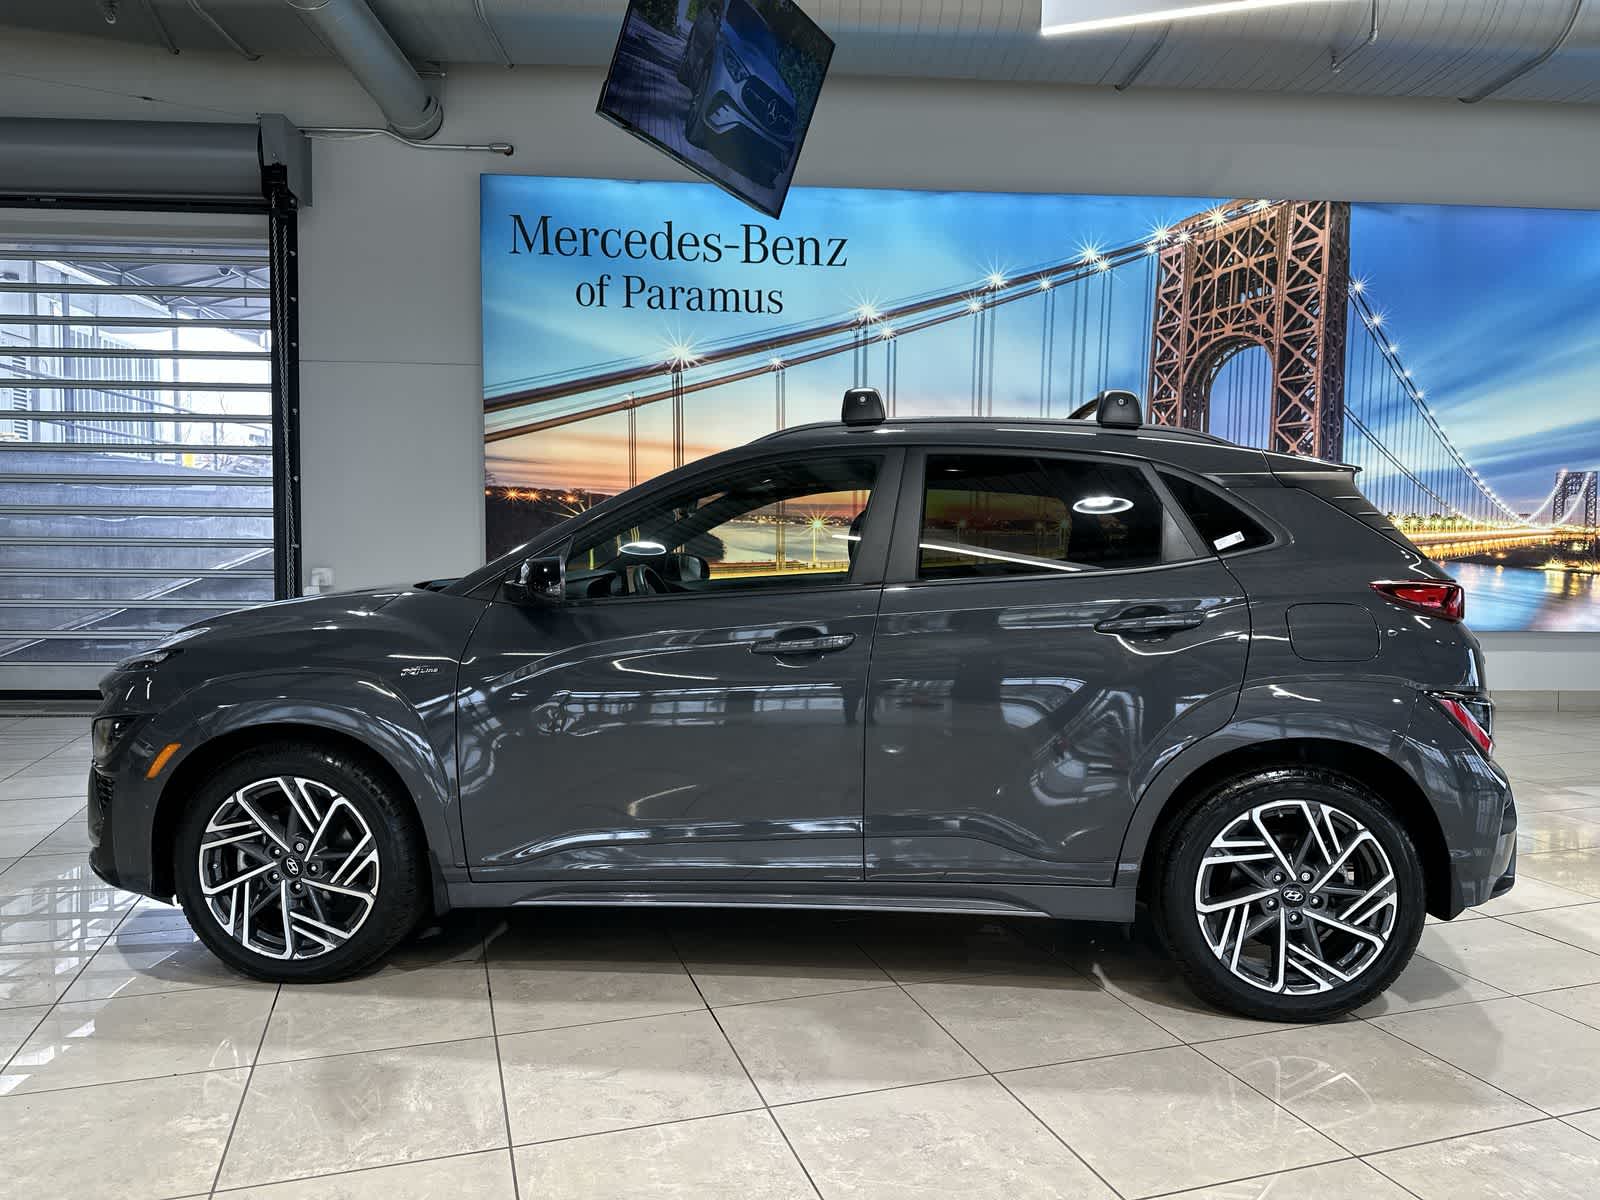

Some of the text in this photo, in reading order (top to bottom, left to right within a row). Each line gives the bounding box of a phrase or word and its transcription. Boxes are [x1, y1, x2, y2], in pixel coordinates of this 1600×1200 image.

[509, 213, 848, 267] Mercedes-Benz
[575, 275, 784, 314] of Paramus
